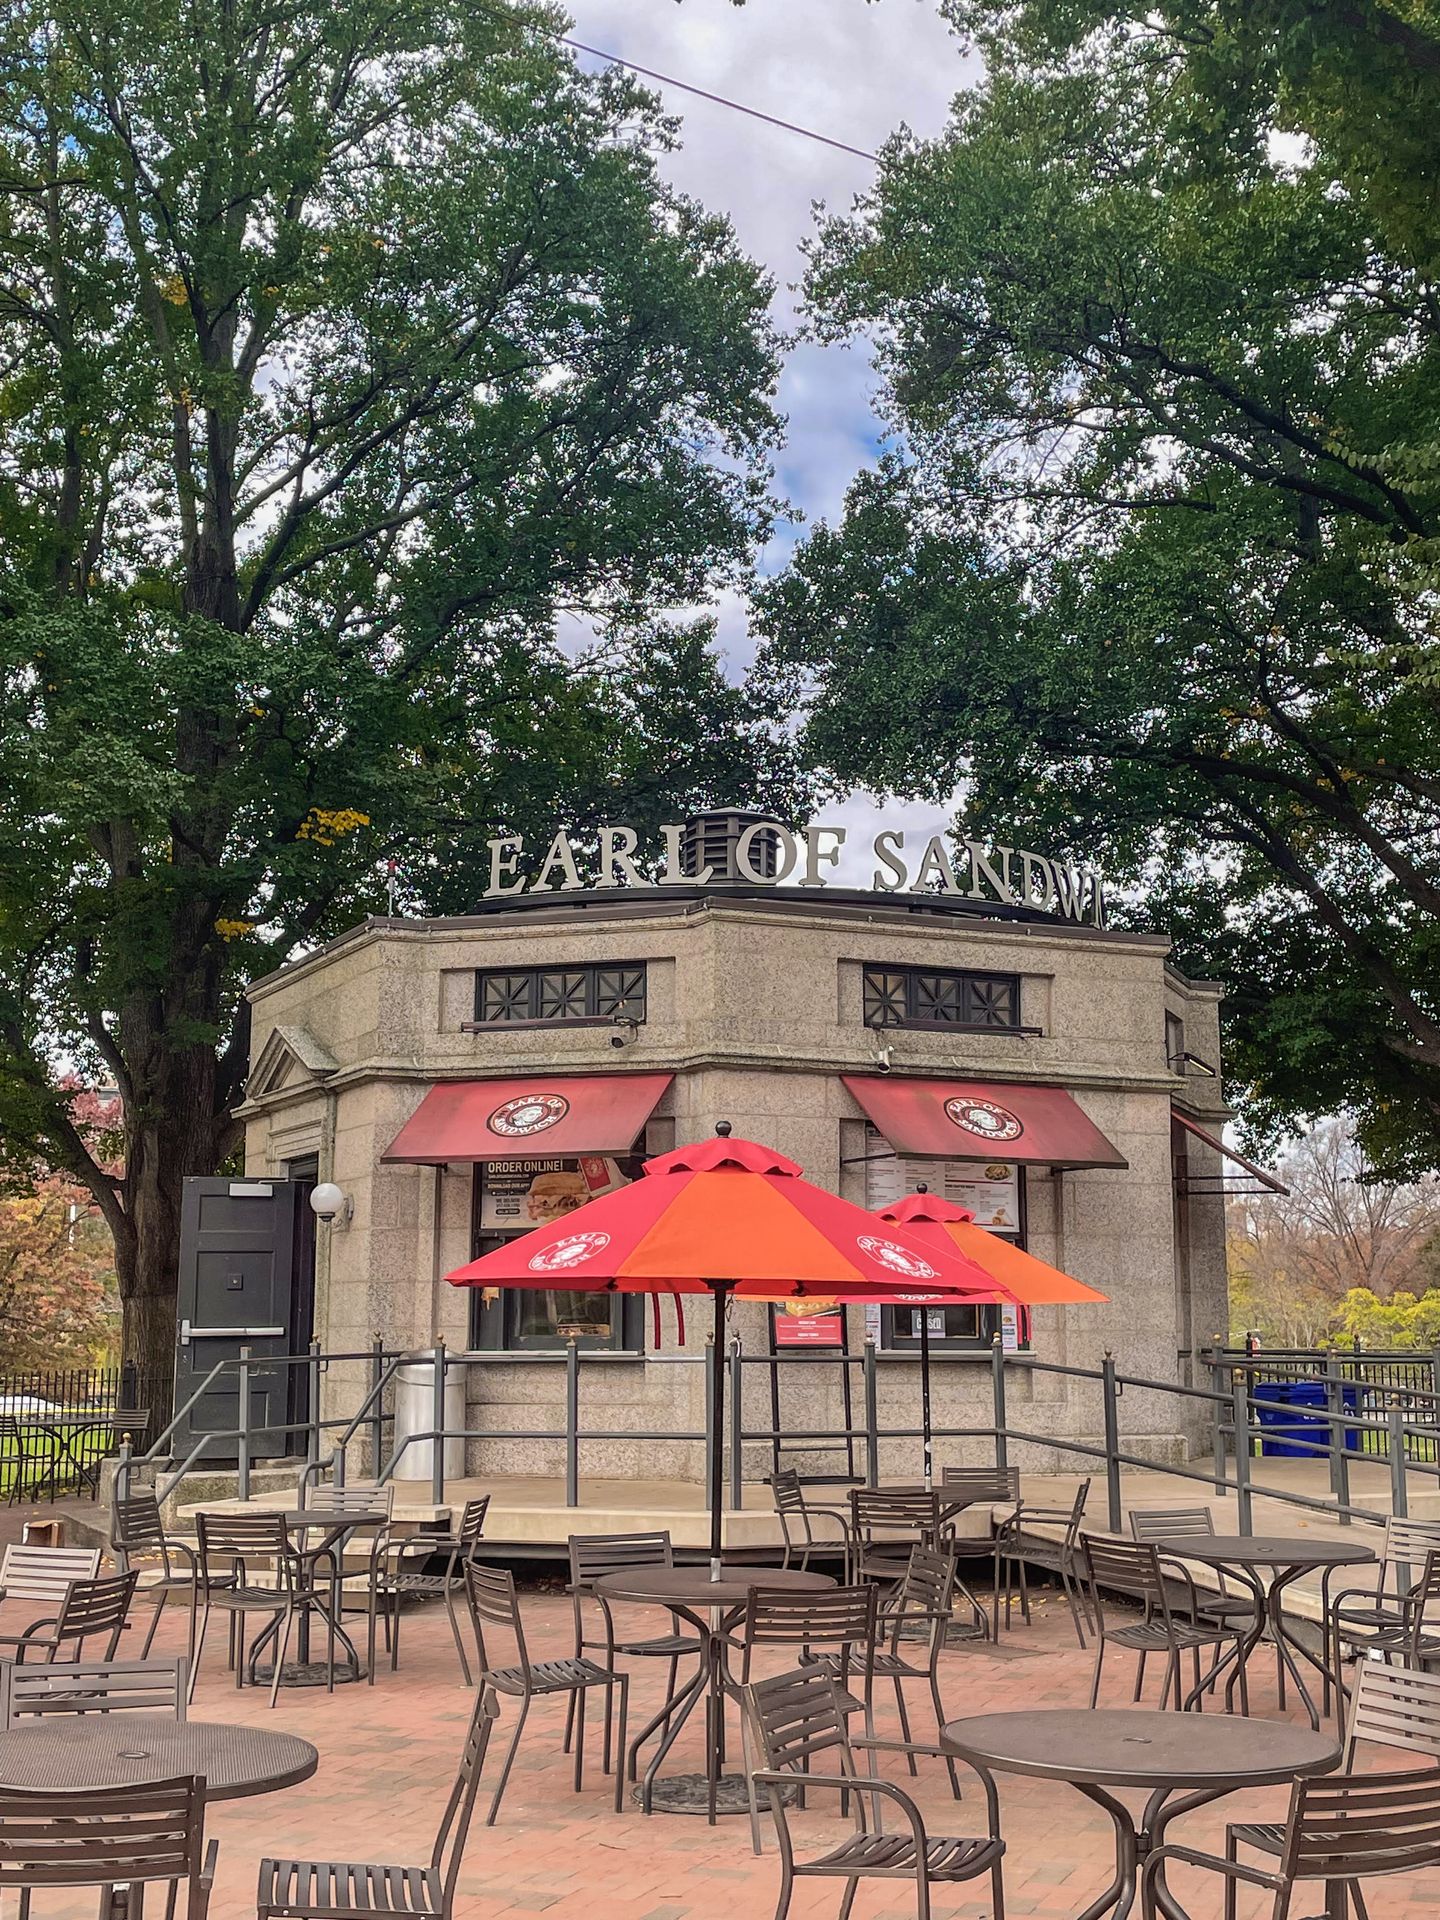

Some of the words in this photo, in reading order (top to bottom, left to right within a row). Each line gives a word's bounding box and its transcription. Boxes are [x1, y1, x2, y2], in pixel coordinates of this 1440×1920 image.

[483, 823, 714, 898] EARL
[736, 822, 846, 886] OF
[507, 1096, 545, 1110] EARL
[547, 1099, 562, 1108] OF
[949, 1100, 979, 1112] EARL
[983, 1103, 1002, 1113] OF
[494, 1116, 557, 1134] SANDWICH
[958, 1119, 1017, 1138] SANDWICH
[488, 1161, 522, 1173] ORDER
[524, 1159, 563, 1172] ONLINE!
